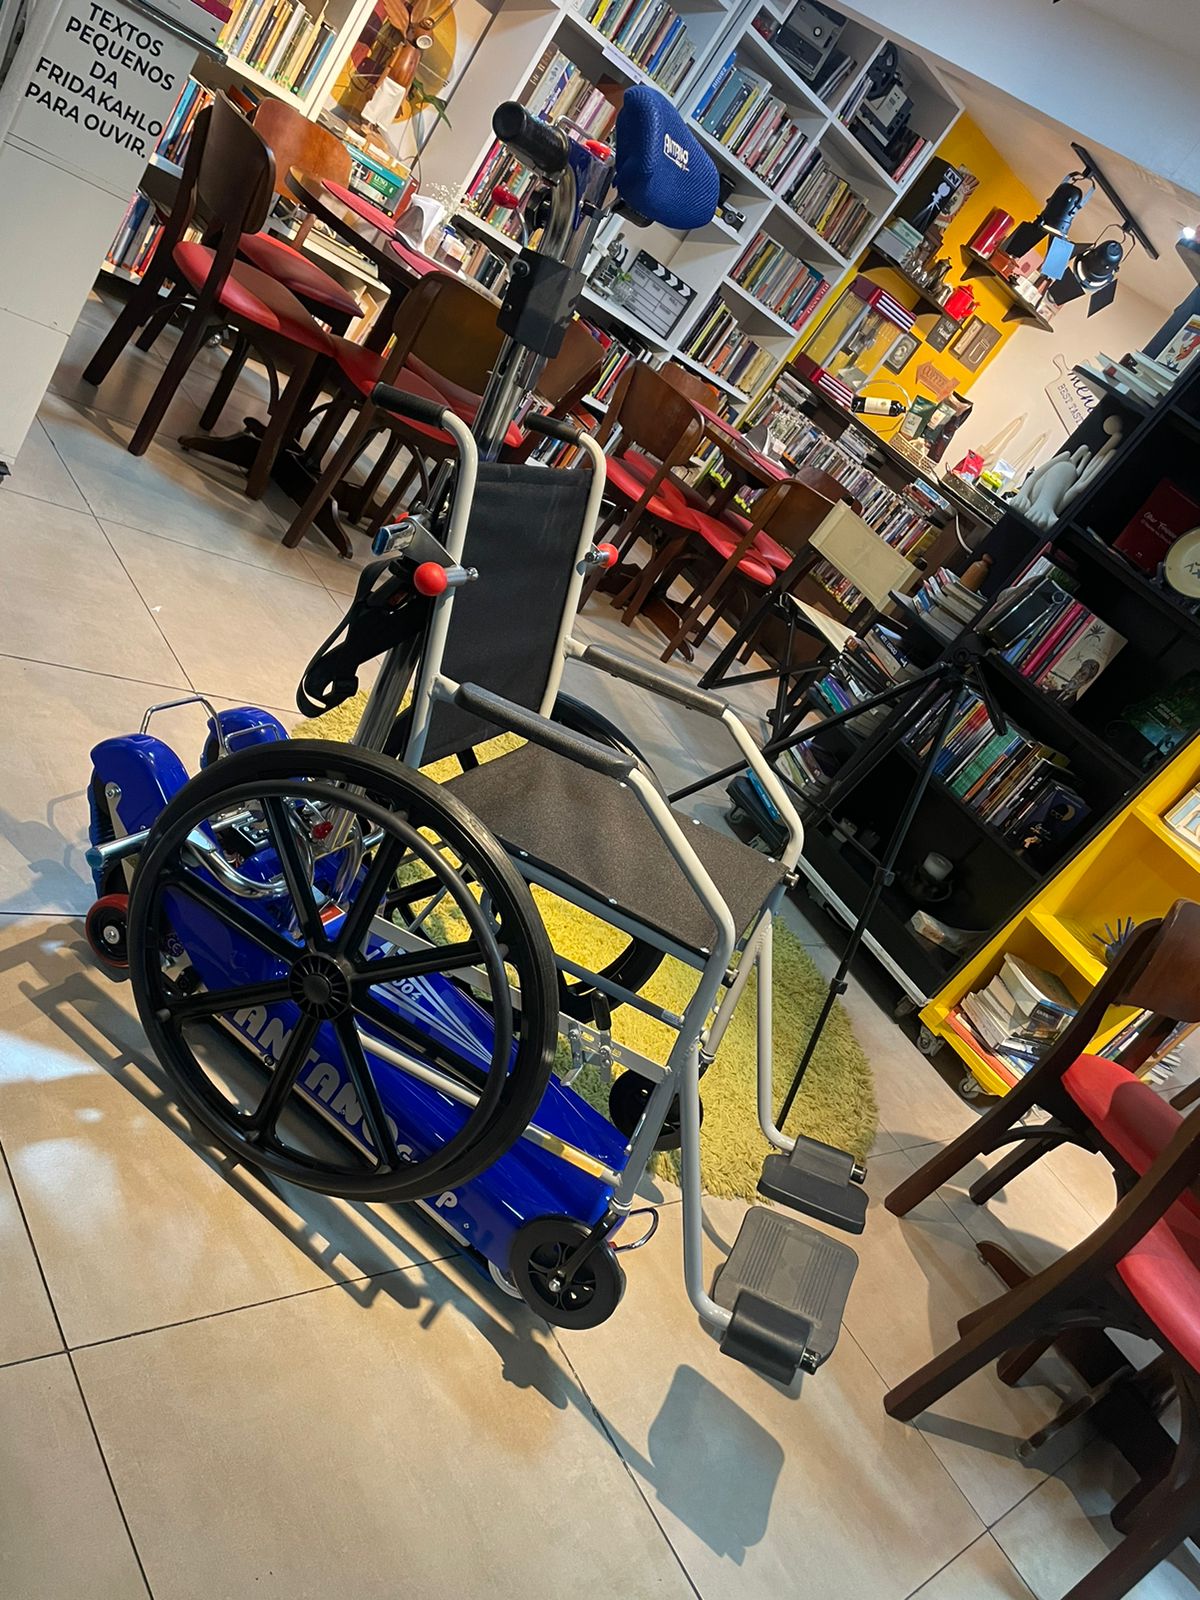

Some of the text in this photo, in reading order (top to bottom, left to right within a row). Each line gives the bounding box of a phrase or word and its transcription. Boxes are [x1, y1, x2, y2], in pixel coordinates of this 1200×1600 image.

[65, 16, 175, 91] PEQUENOS
[89, 2, 164, 57] TEXTOS
[35, 56, 163, 137] FRIDAKAHLO
[89, 61, 118, 89] DA
[25, 81, 146, 158] PARA OUVIR.
[1067, 372, 1094, 412] men
